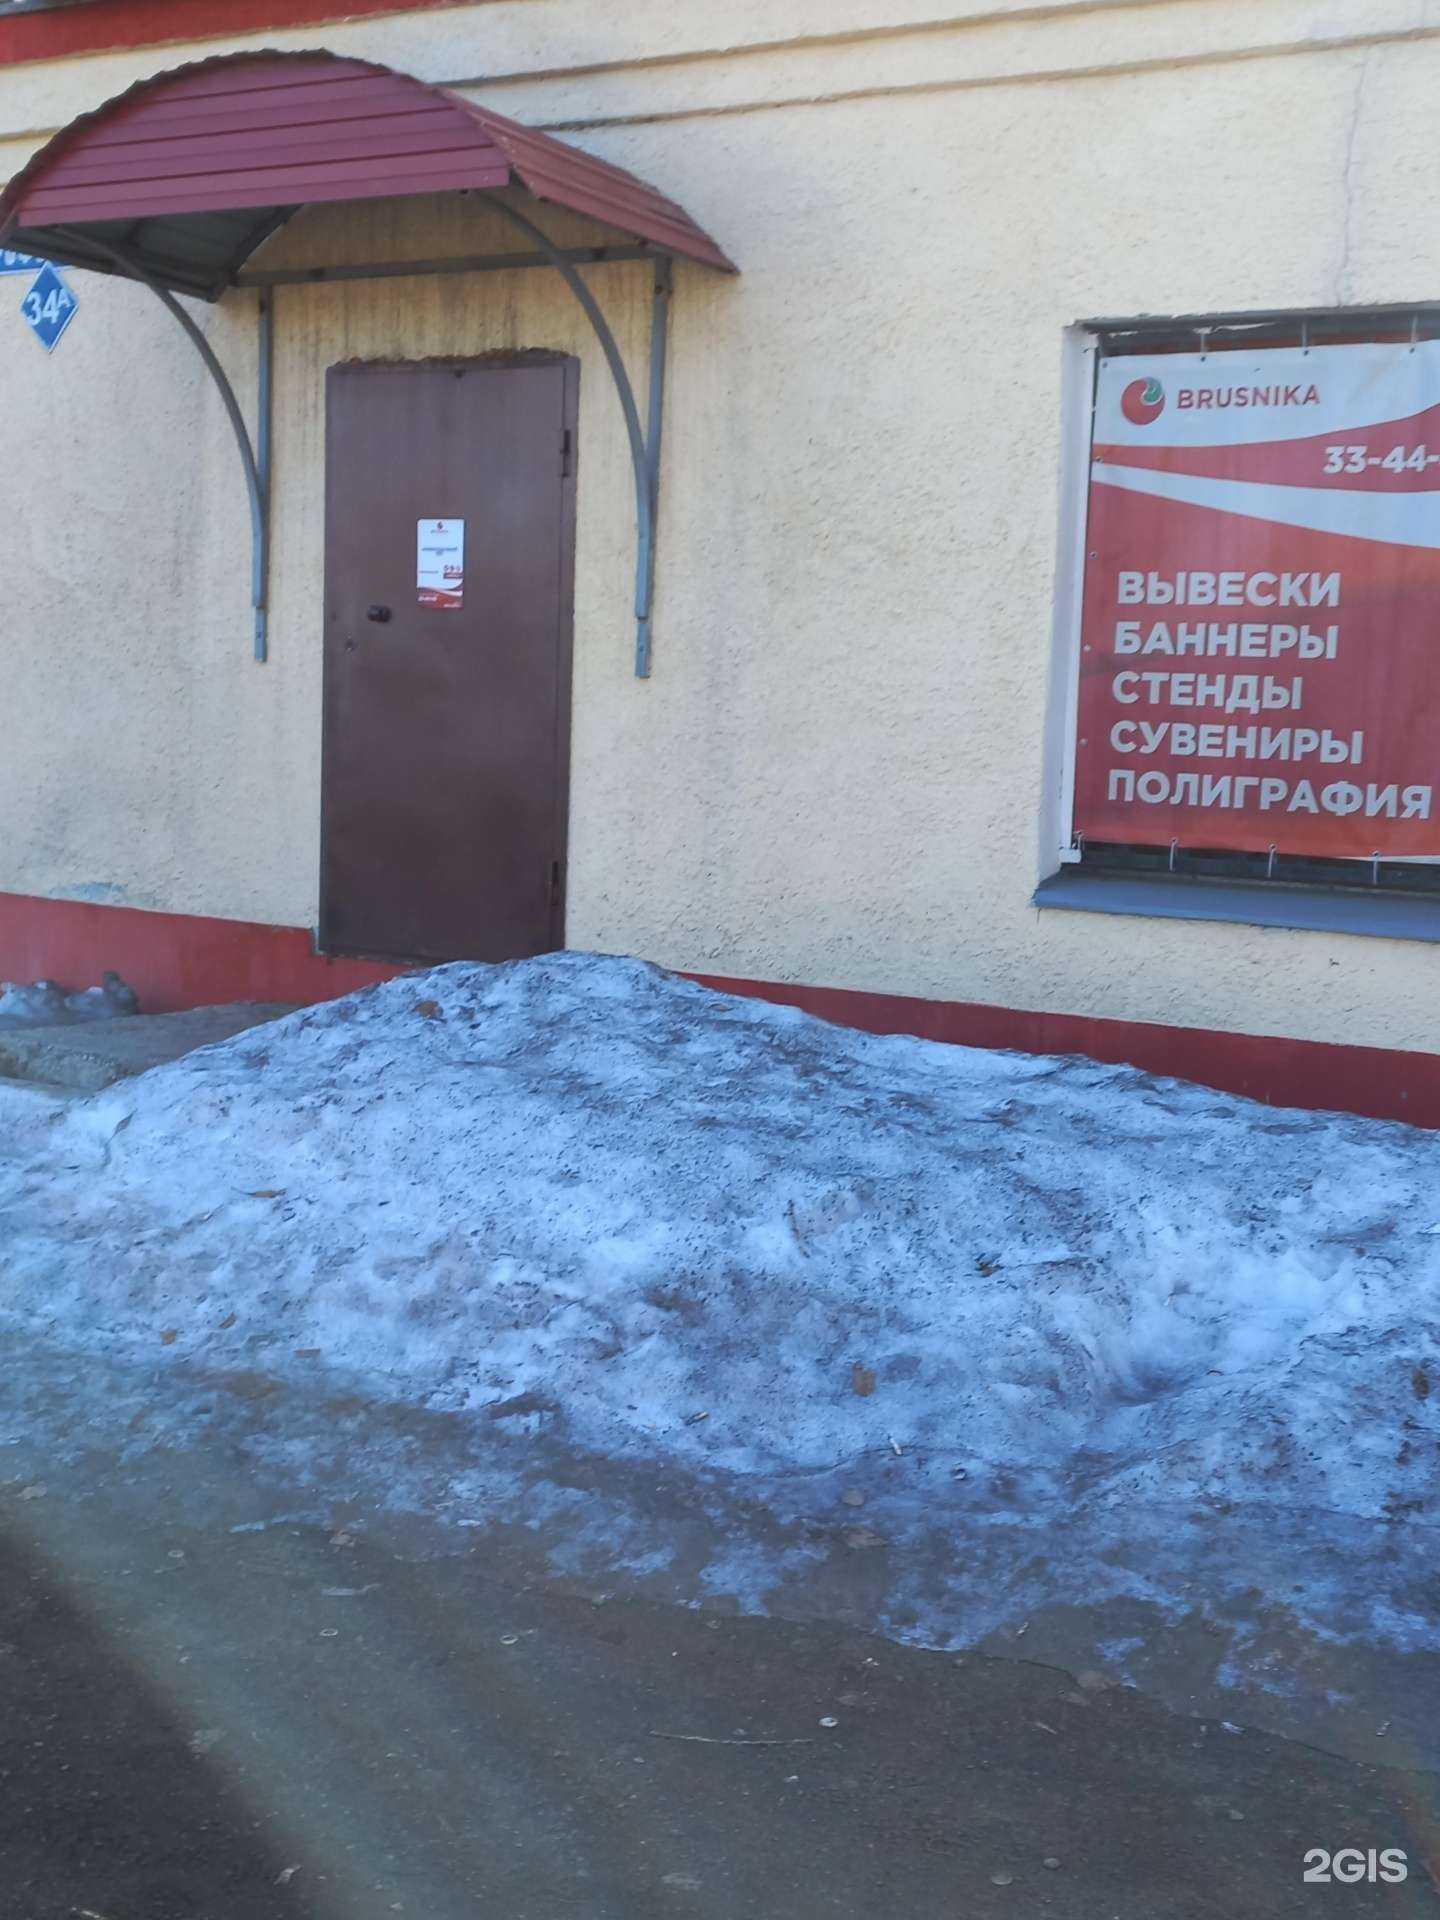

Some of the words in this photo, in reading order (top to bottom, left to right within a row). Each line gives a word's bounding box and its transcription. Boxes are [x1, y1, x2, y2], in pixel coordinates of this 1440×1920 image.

[1176, 384, 1320, 410] BRUSNIKA
[1117, 571, 1341, 608] ВЫВЕСКИ
[1113, 621, 1339, 659] БАННЕРЫ
[1112, 671, 1303, 714] СТЕНДЫ
[1110, 720, 1363, 764] СУВЕНИРЫ
[1108, 769, 1432, 819] ПОЛИГРАФИЯ
